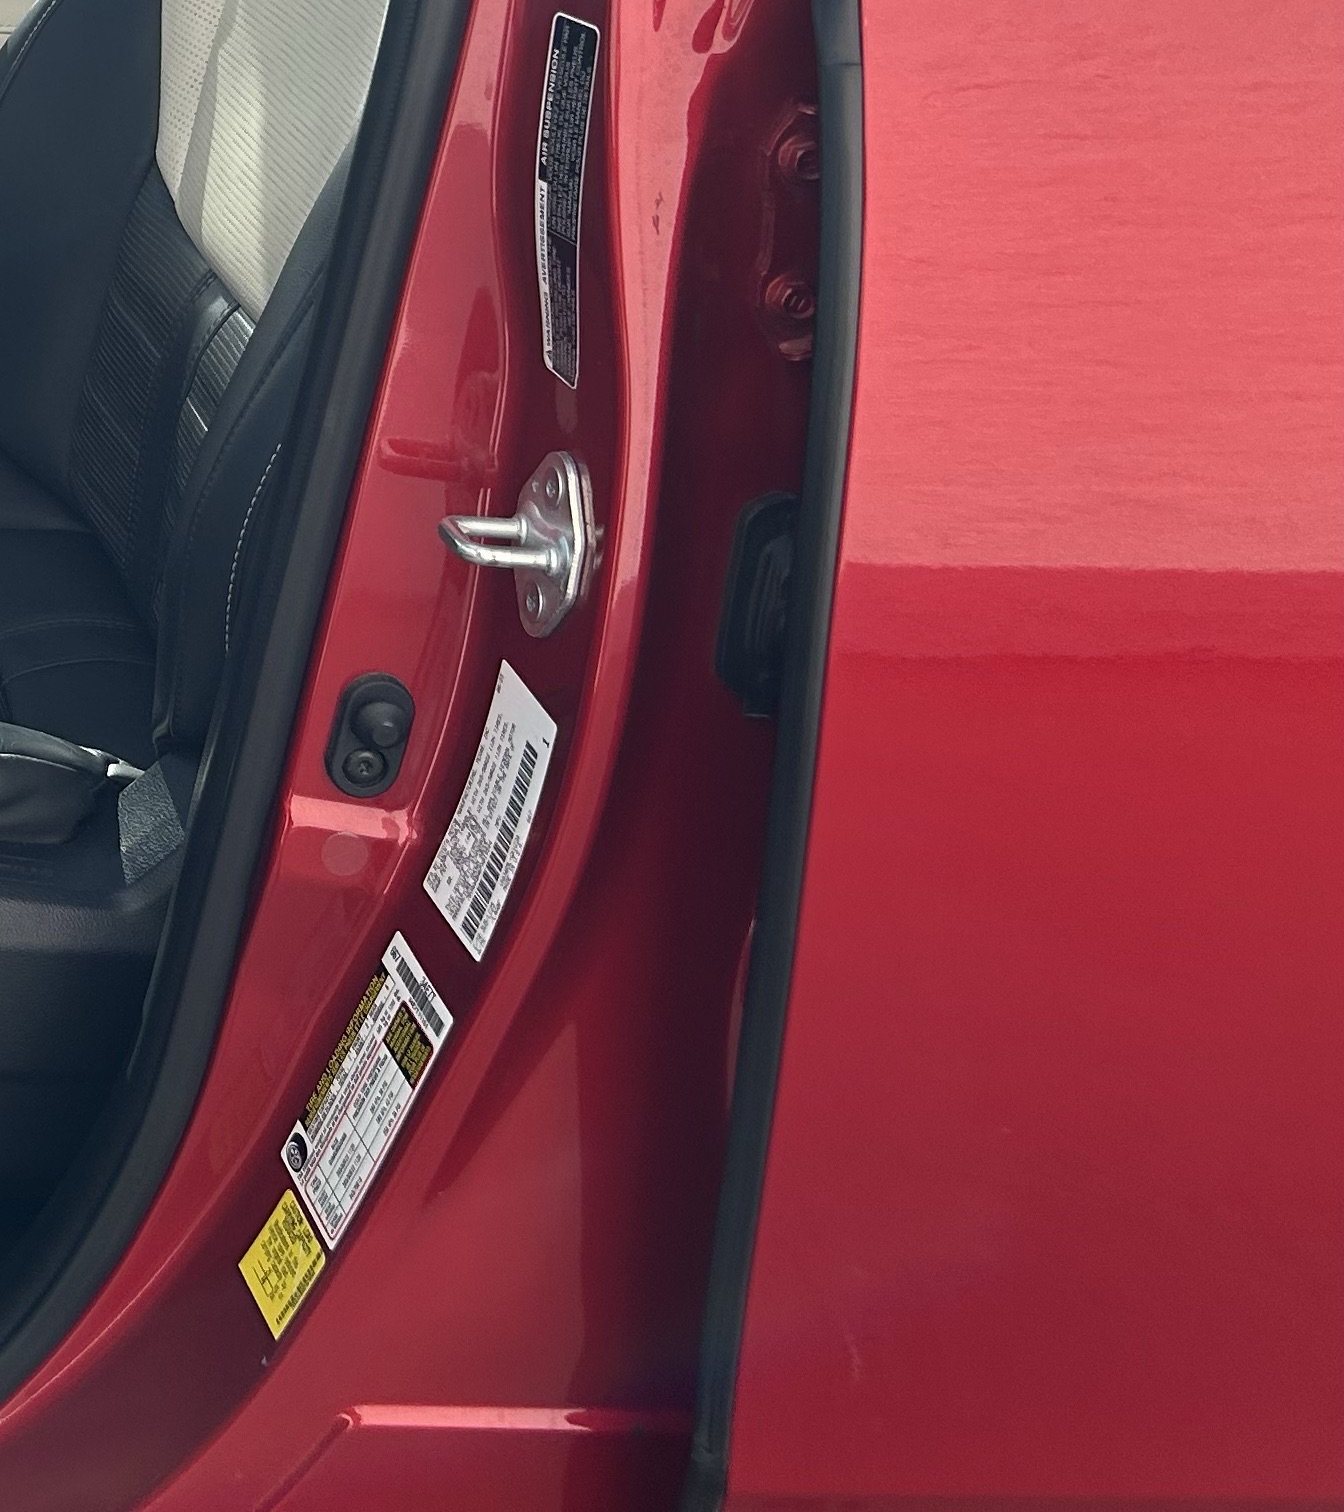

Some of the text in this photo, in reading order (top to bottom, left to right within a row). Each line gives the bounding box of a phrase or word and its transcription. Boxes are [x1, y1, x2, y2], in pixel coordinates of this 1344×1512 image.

[540, 49, 559, 165] AIR SUSPENSION
[541, 737, 549, 748] 1
[345, 973, 380, 1036] INFORMATION
